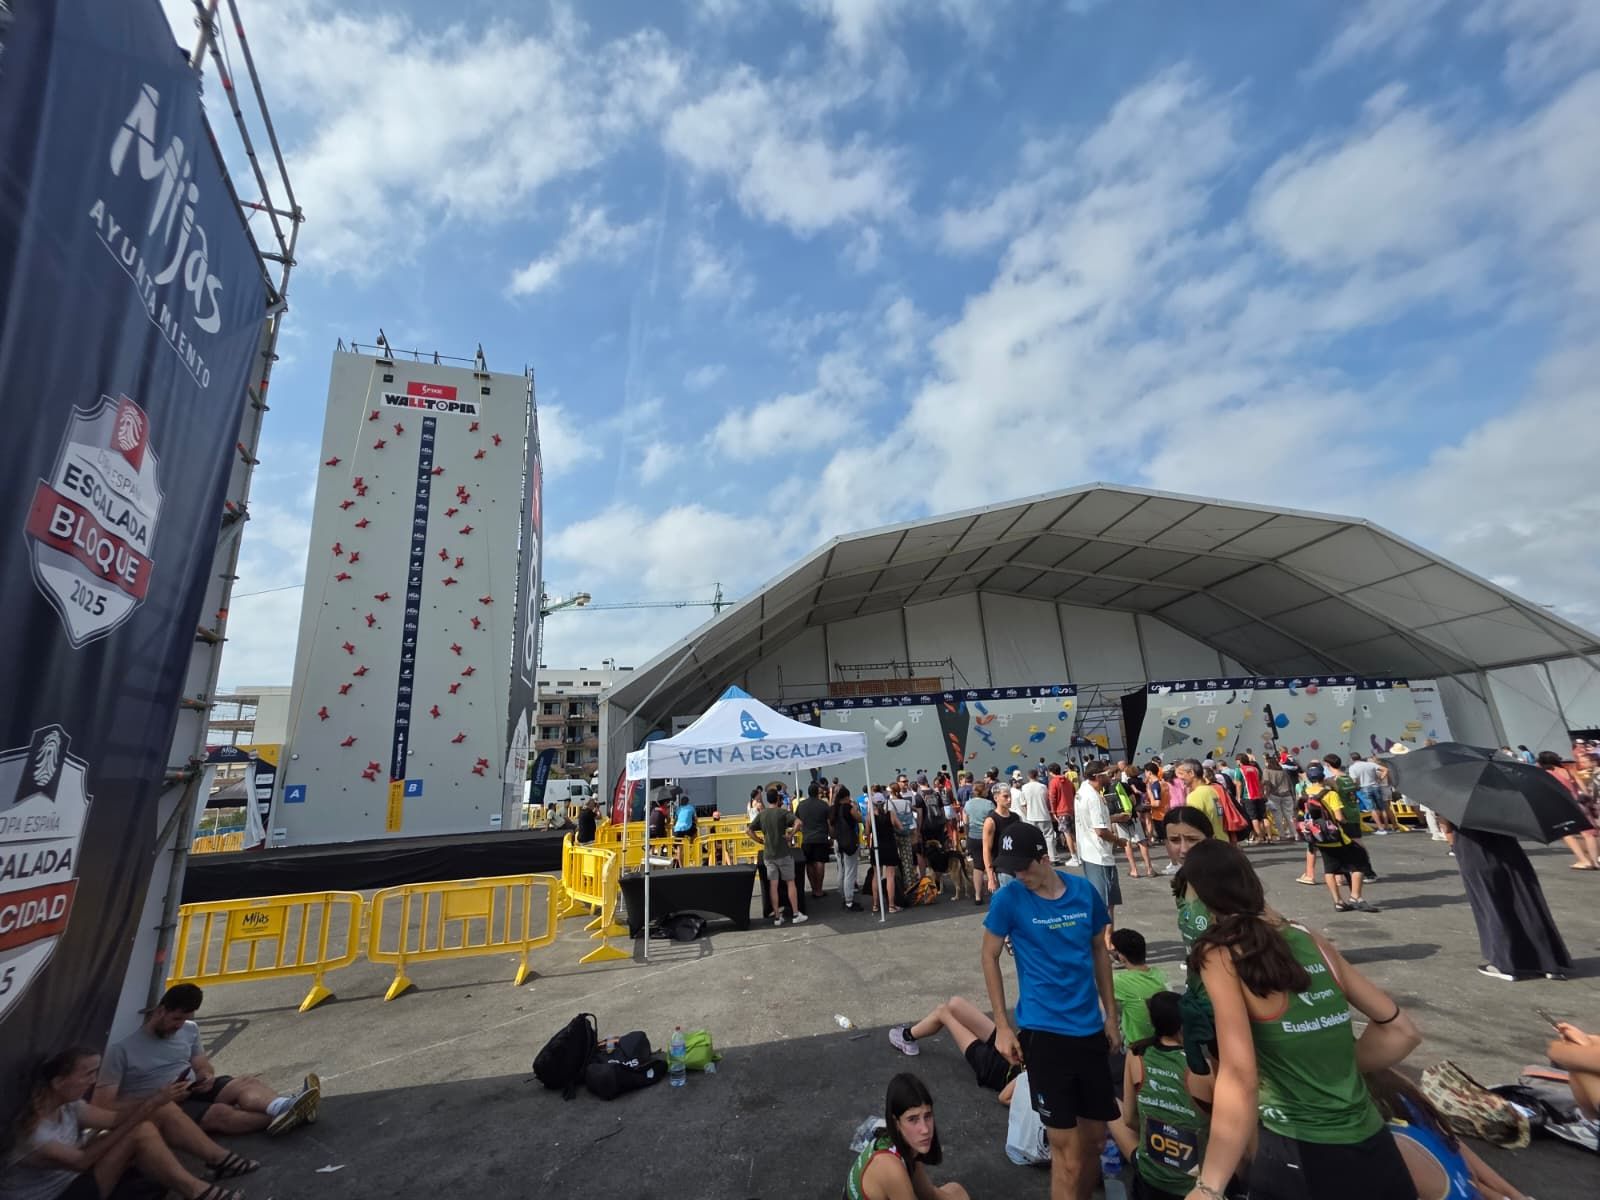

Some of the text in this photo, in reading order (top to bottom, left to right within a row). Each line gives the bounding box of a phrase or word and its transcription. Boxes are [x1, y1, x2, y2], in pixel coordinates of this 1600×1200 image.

[110, 82, 223, 334] Mijas
[89, 199, 210, 389] AYUNTAMIENTO
[385, 394, 476, 415] WALLTOPIA
[62, 462, 147, 547] ESCALADA
[48, 503, 140, 585] BLOQUE
[70, 579, 108, 617] 2025
[679, 747, 722, 766] VEN
[730, 746, 744, 762] A
[290, 789, 300, 799] A
[408, 783, 418, 793] B
[1282, 1018, 1321, 1033] Euskal
[1151, 1133, 1193, 1161] 057
